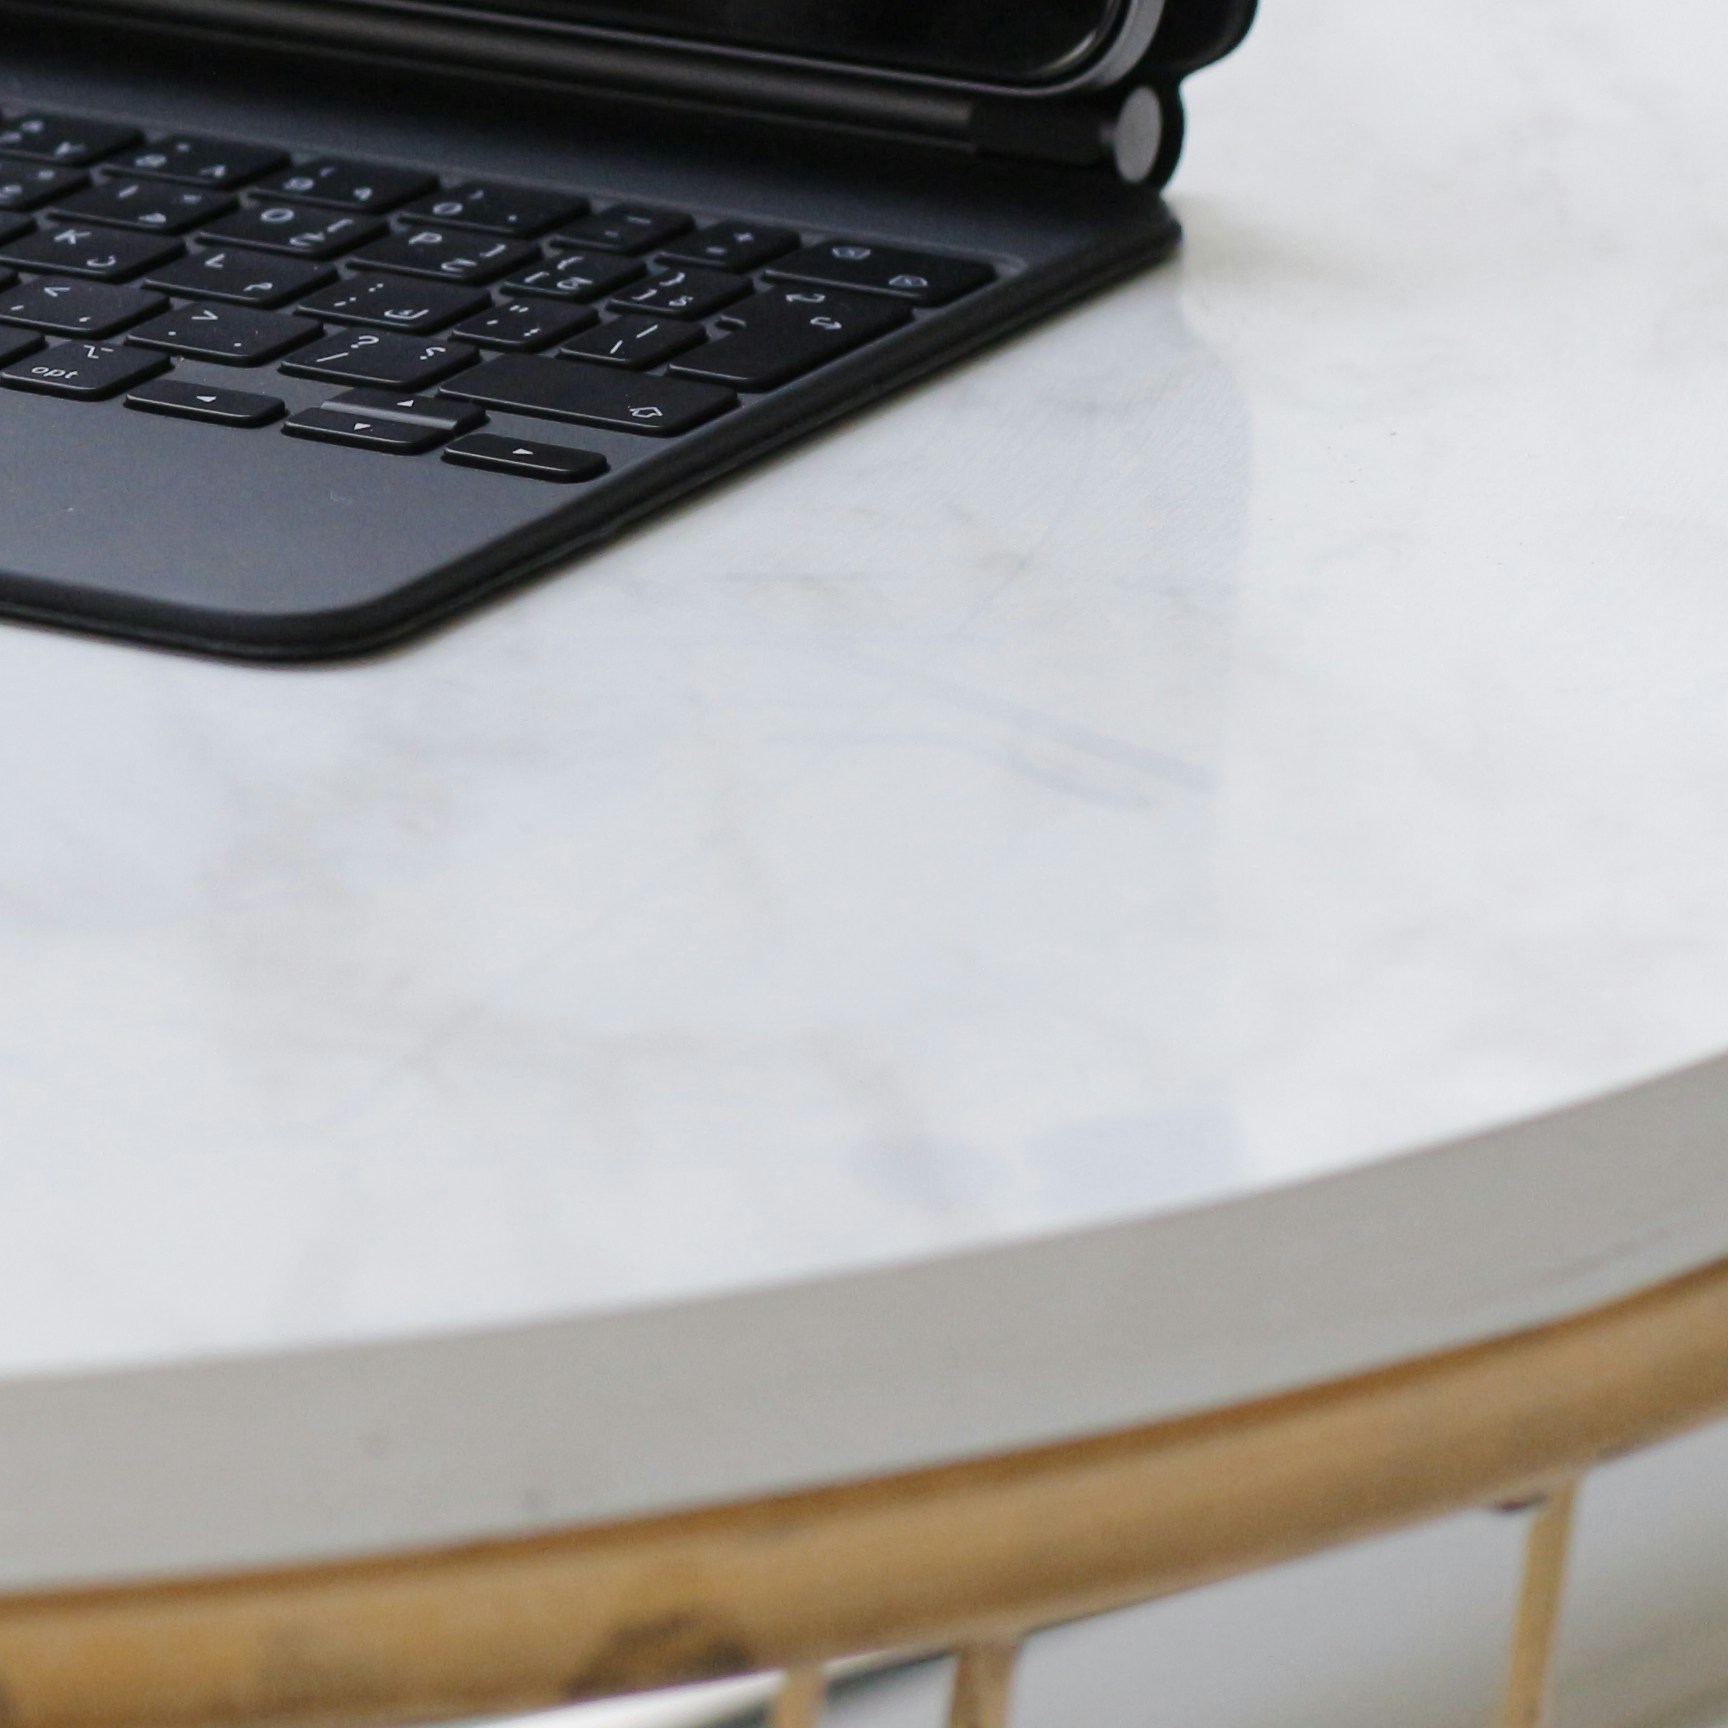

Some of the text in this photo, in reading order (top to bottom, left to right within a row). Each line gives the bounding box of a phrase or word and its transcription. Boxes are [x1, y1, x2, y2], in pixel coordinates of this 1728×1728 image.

[54, 229, 92, 245] K
[204, 252, 227, 269] L
[31, 365, 79, 380] opt
